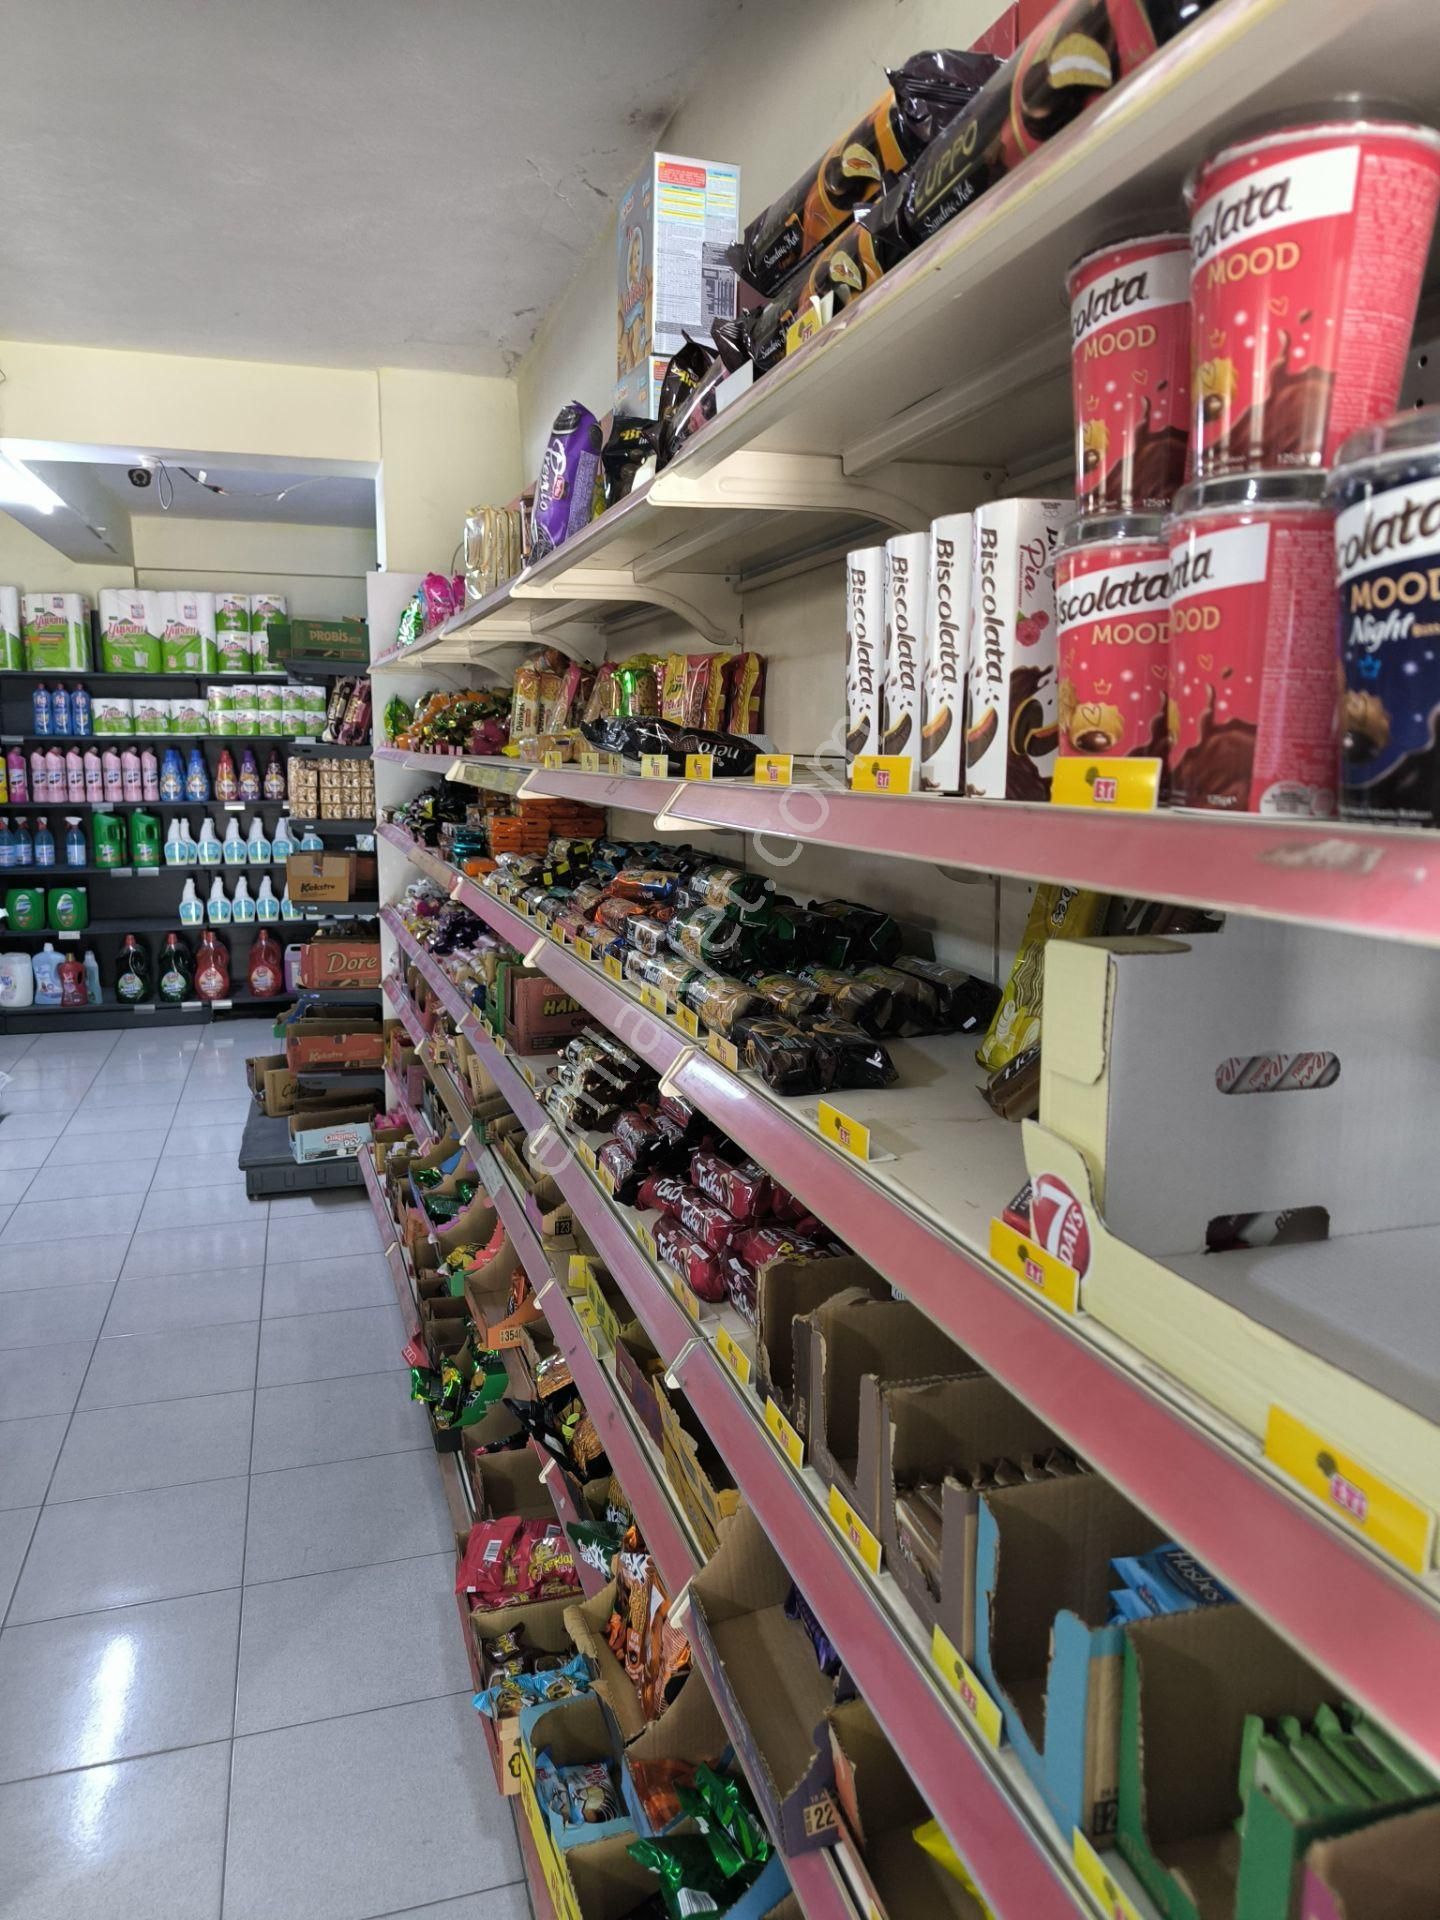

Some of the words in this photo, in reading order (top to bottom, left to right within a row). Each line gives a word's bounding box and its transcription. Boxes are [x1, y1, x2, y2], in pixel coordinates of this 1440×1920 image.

[1206, 241, 1300, 290] MOOD
[1083, 325, 1156, 363] MOOD
[1019, 538, 1046, 599] Pia
[851, 568, 875, 695] Biscolata
[892, 556, 917, 692] Biscolata
[936, 538, 960, 684] Biscolata
[981, 527, 1005, 684] Biscolata
[327, 951, 377, 973] Dore
[1058, 1206, 1085, 1268] DAYS
[814, 1803, 835, 1830] 22
